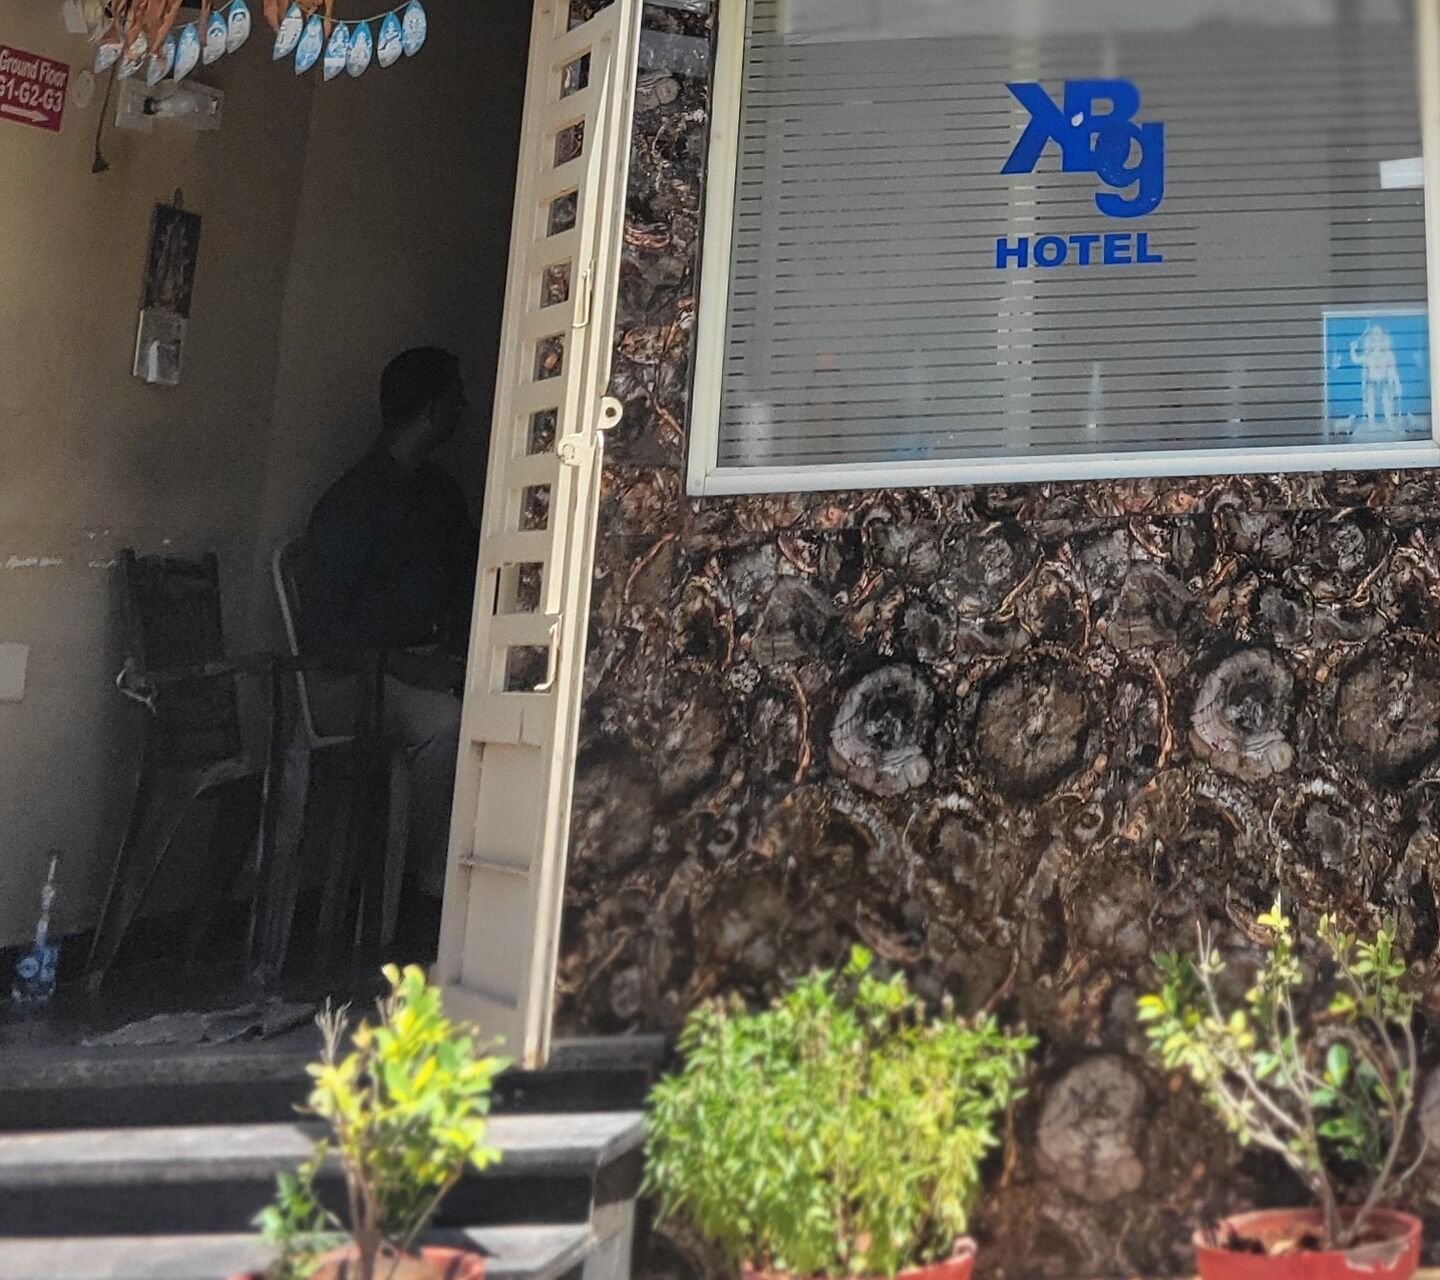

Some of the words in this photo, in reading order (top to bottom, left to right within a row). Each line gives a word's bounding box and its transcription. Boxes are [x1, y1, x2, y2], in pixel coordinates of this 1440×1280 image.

[0, 49, 38, 80] Ground
[40, 61, 67, 88] Floor
[995, 231, 1164, 270] HOTEL
